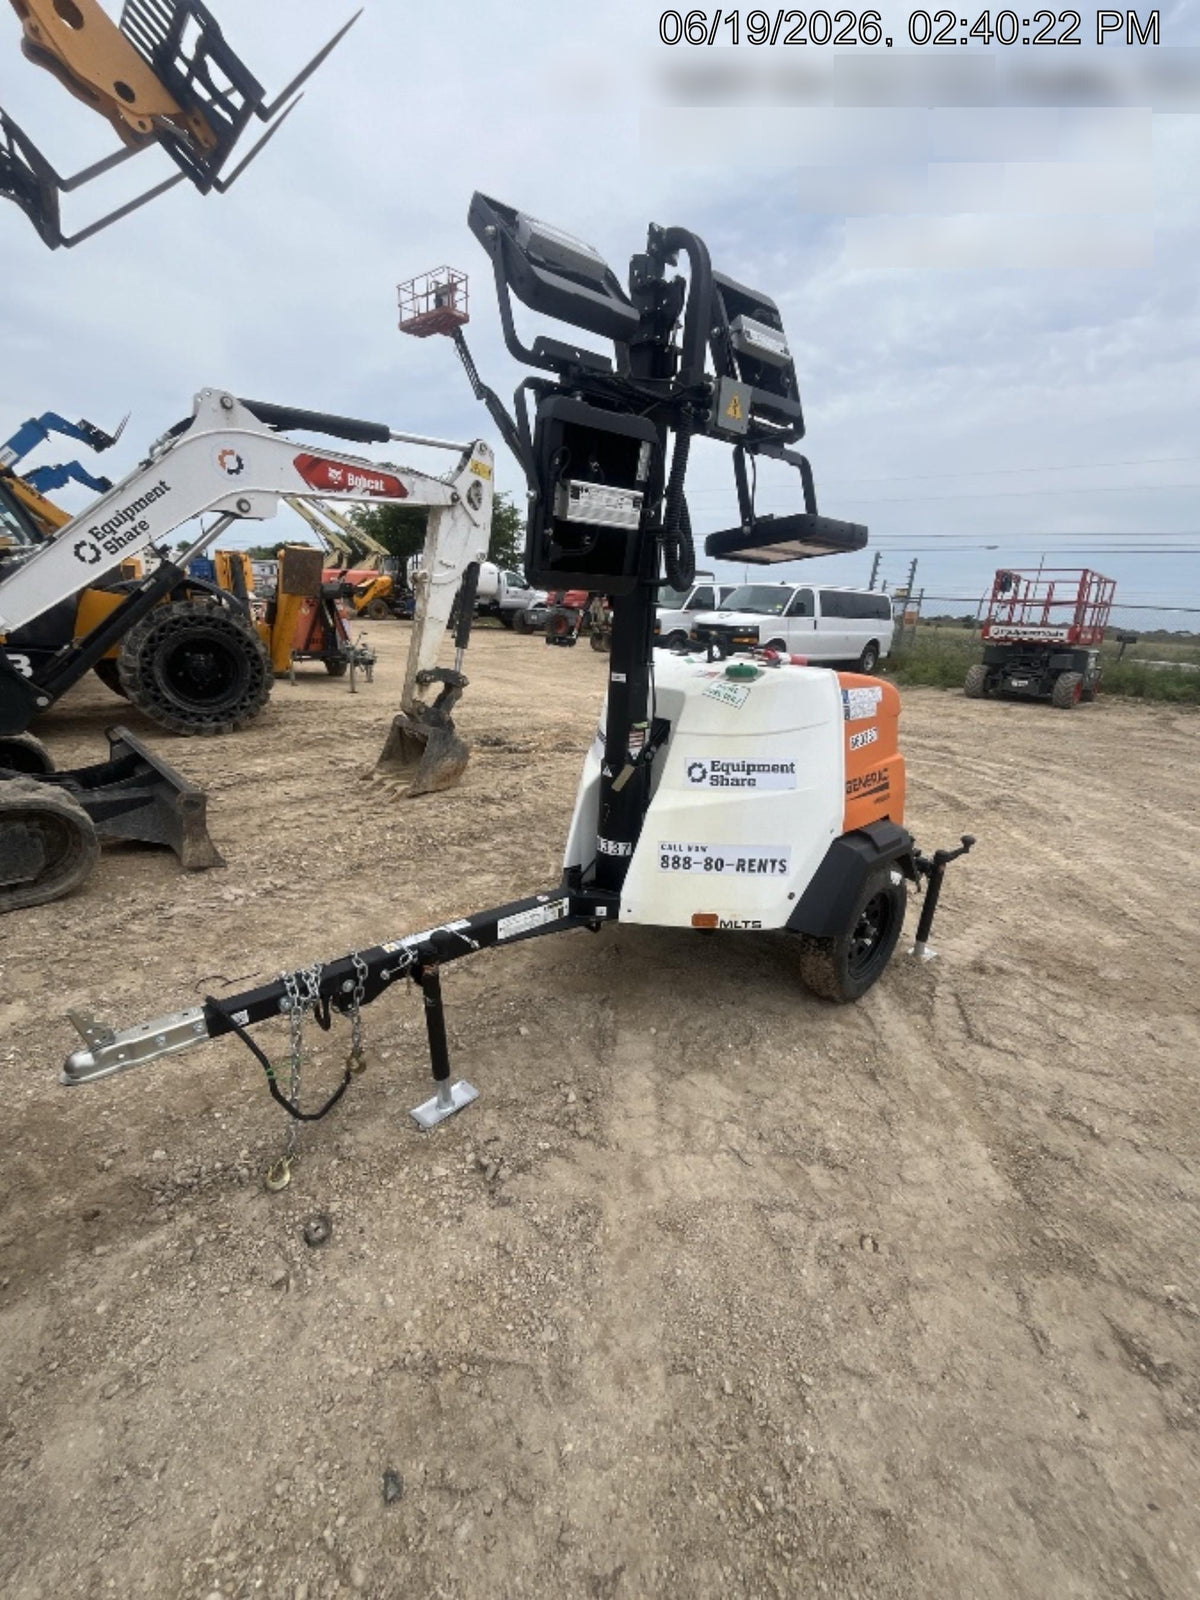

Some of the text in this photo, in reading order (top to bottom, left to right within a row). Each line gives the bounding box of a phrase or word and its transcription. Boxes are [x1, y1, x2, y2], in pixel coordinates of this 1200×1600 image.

[347, 473, 386, 491] Bobcat
[88, 480, 171, 541] Equipment
[102, 519, 150, 555] Share
[710, 760, 796, 775] Equipment
[709, 774, 757, 787] Share
[660, 843, 683, 852] CALL
[660, 854, 788, 874] 888-80-RENTS
[719, 920, 762, 929] MLTS
